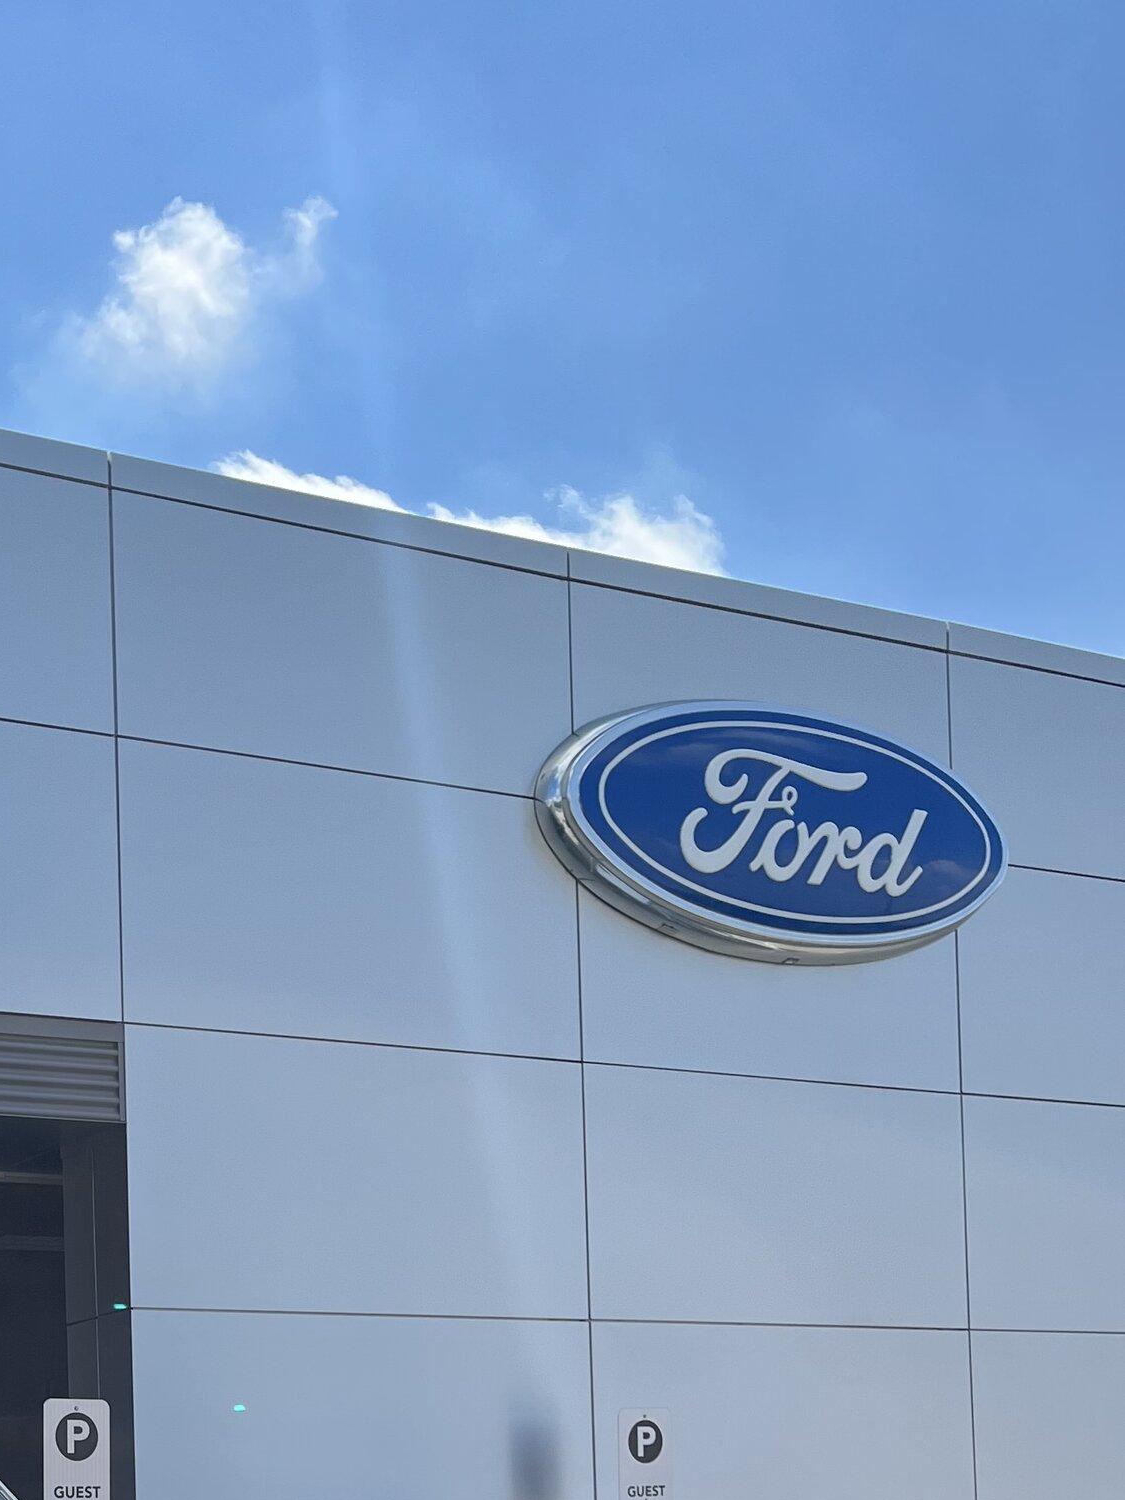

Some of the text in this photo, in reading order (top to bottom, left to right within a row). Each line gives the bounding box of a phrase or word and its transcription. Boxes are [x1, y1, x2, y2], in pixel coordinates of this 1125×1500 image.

[679, 748, 929, 898] Ford
[66, 1419, 90, 1454] P
[636, 1425, 657, 1458] P
[53, 1485, 101, 1499] GUEST
[627, 1485, 666, 1498] GUEST
